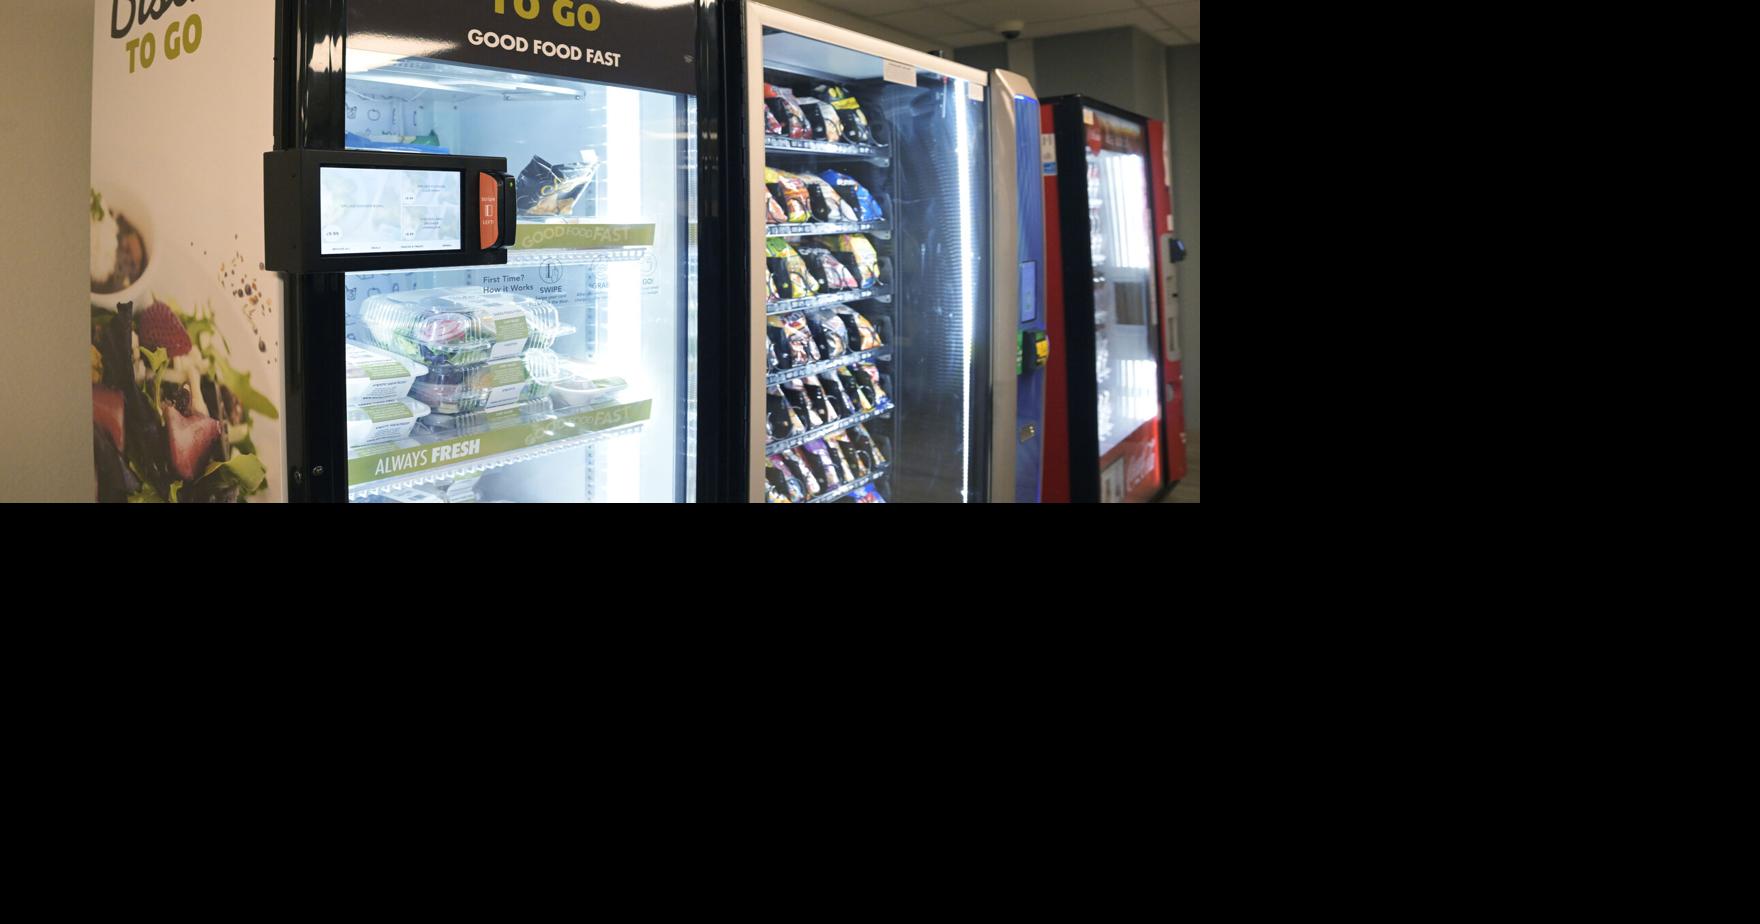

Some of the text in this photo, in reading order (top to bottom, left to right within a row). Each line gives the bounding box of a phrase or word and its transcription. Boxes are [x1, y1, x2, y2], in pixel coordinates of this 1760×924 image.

[111, 0, 195, 38] Dis
[552, 0, 601, 32] GO
[126, 13, 203, 73] TO GO
[467, 28, 621, 67] GOOD FOOD FAST
[522, 226, 565, 248] GOOD
[593, 226, 632, 241] FAST
[483, 274, 525, 284] First Time?
[483, 283, 534, 294] How it Works
[540, 285, 562, 294] SWIPE
[594, 405, 633, 425] FAST
[374, 438, 481, 476] ALWAYS FRESH
